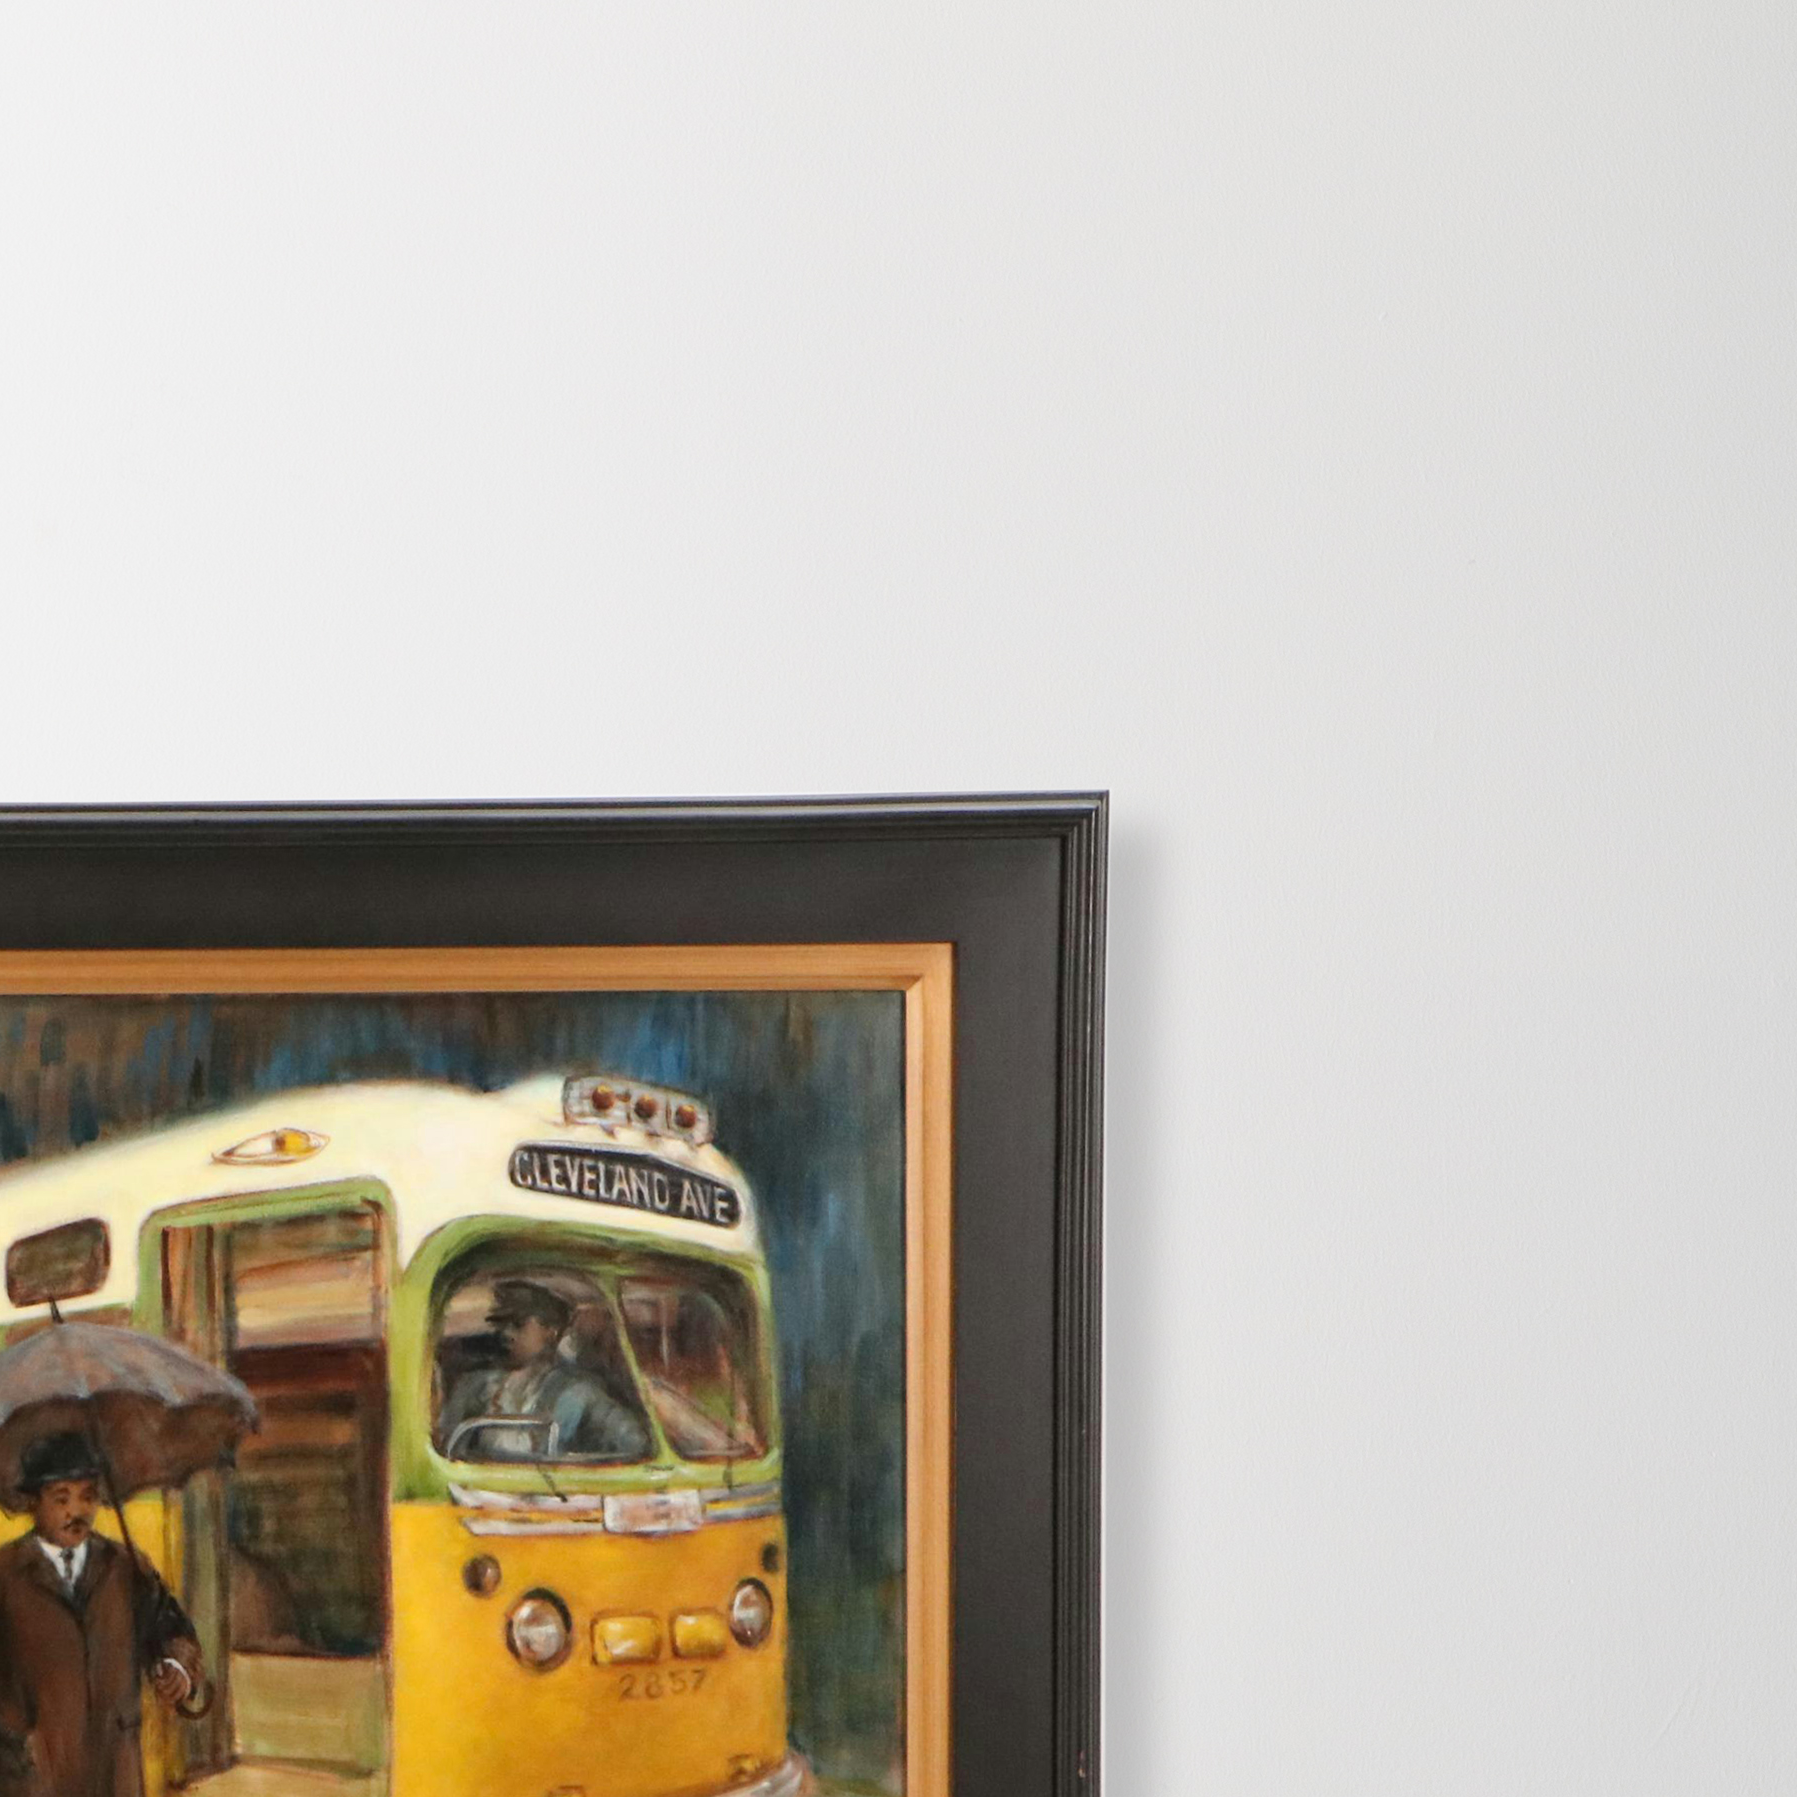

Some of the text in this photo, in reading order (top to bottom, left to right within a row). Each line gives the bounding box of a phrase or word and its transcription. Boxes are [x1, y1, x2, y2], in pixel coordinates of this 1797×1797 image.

[513, 1151, 731, 1223] CLEVELAND AVE
[618, 1669, 706, 1700] 2857
